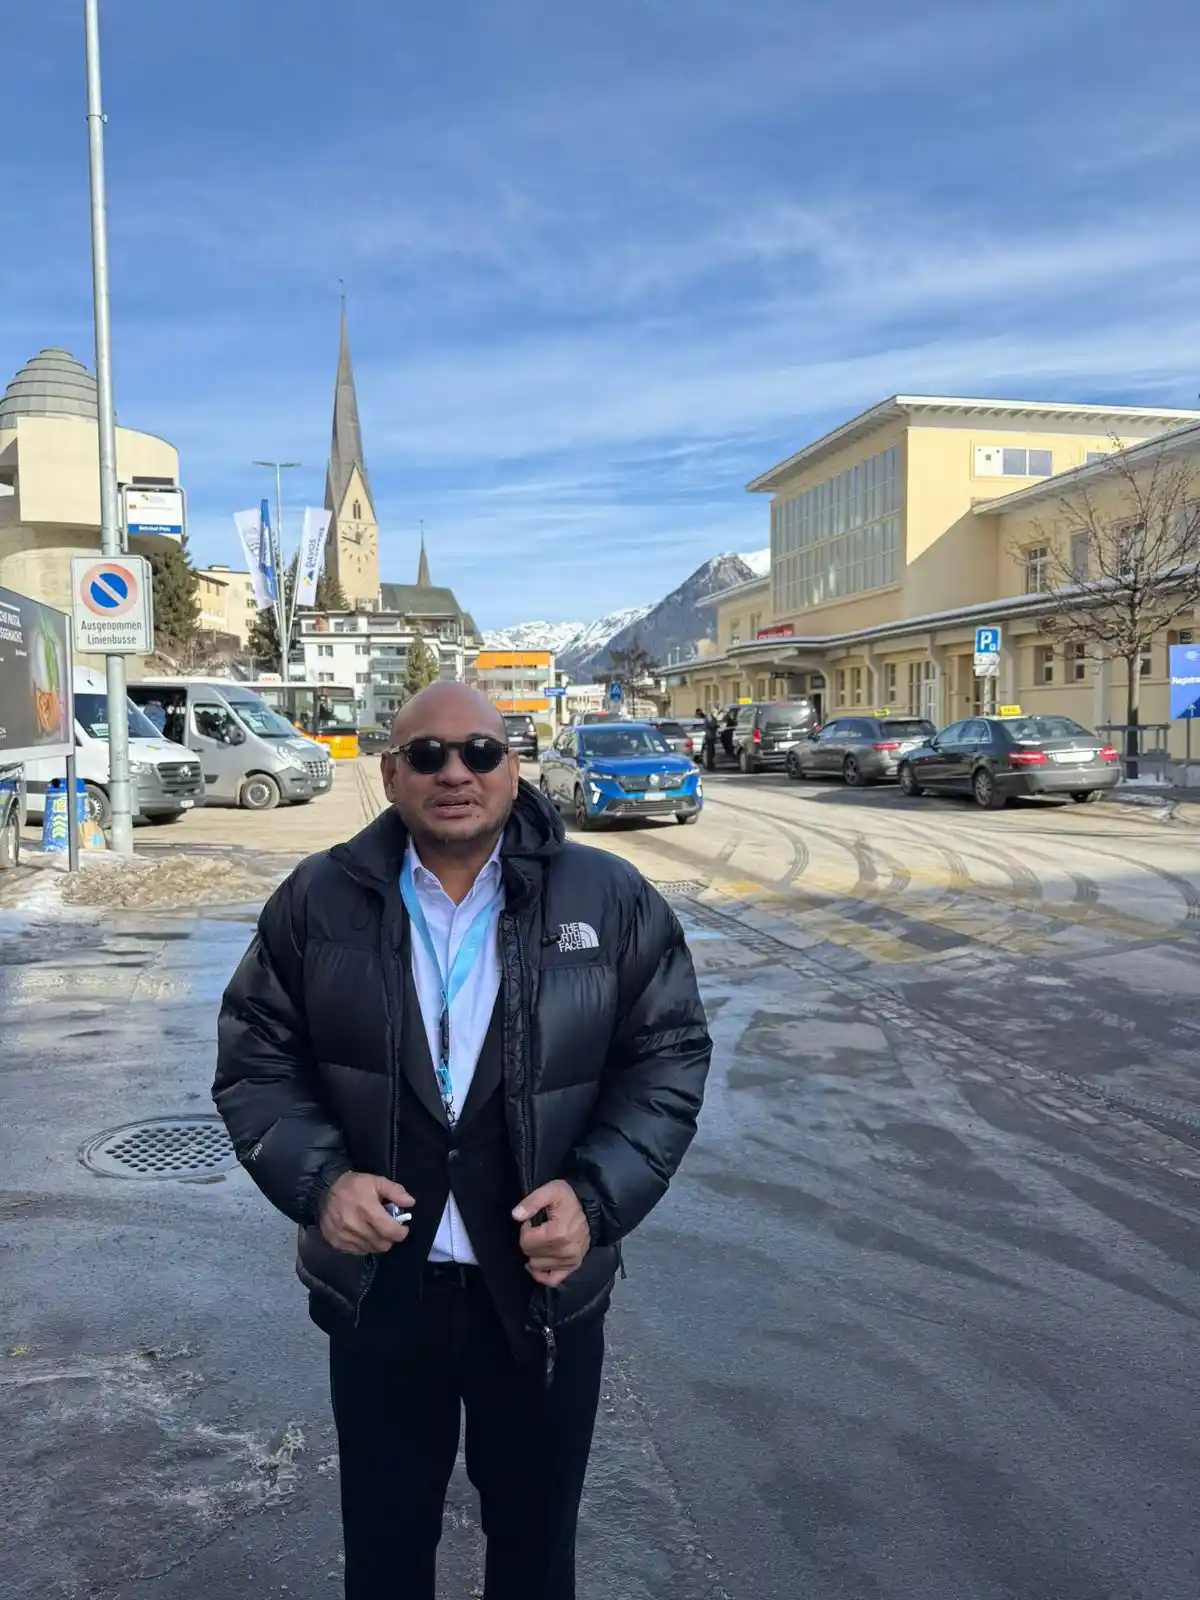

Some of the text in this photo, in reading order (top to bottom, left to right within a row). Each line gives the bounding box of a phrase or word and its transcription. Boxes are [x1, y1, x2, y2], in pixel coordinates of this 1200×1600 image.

[305, 538, 317, 569] DAVOS
[81, 620, 142, 632] Ausgenommen
[87, 634, 137, 645] Linienbusse
[980, 631, 992, 650] P
[559, 922, 579, 934] THE
[556, 931, 581, 943] RTH
[559, 940, 582, 952] FACE
